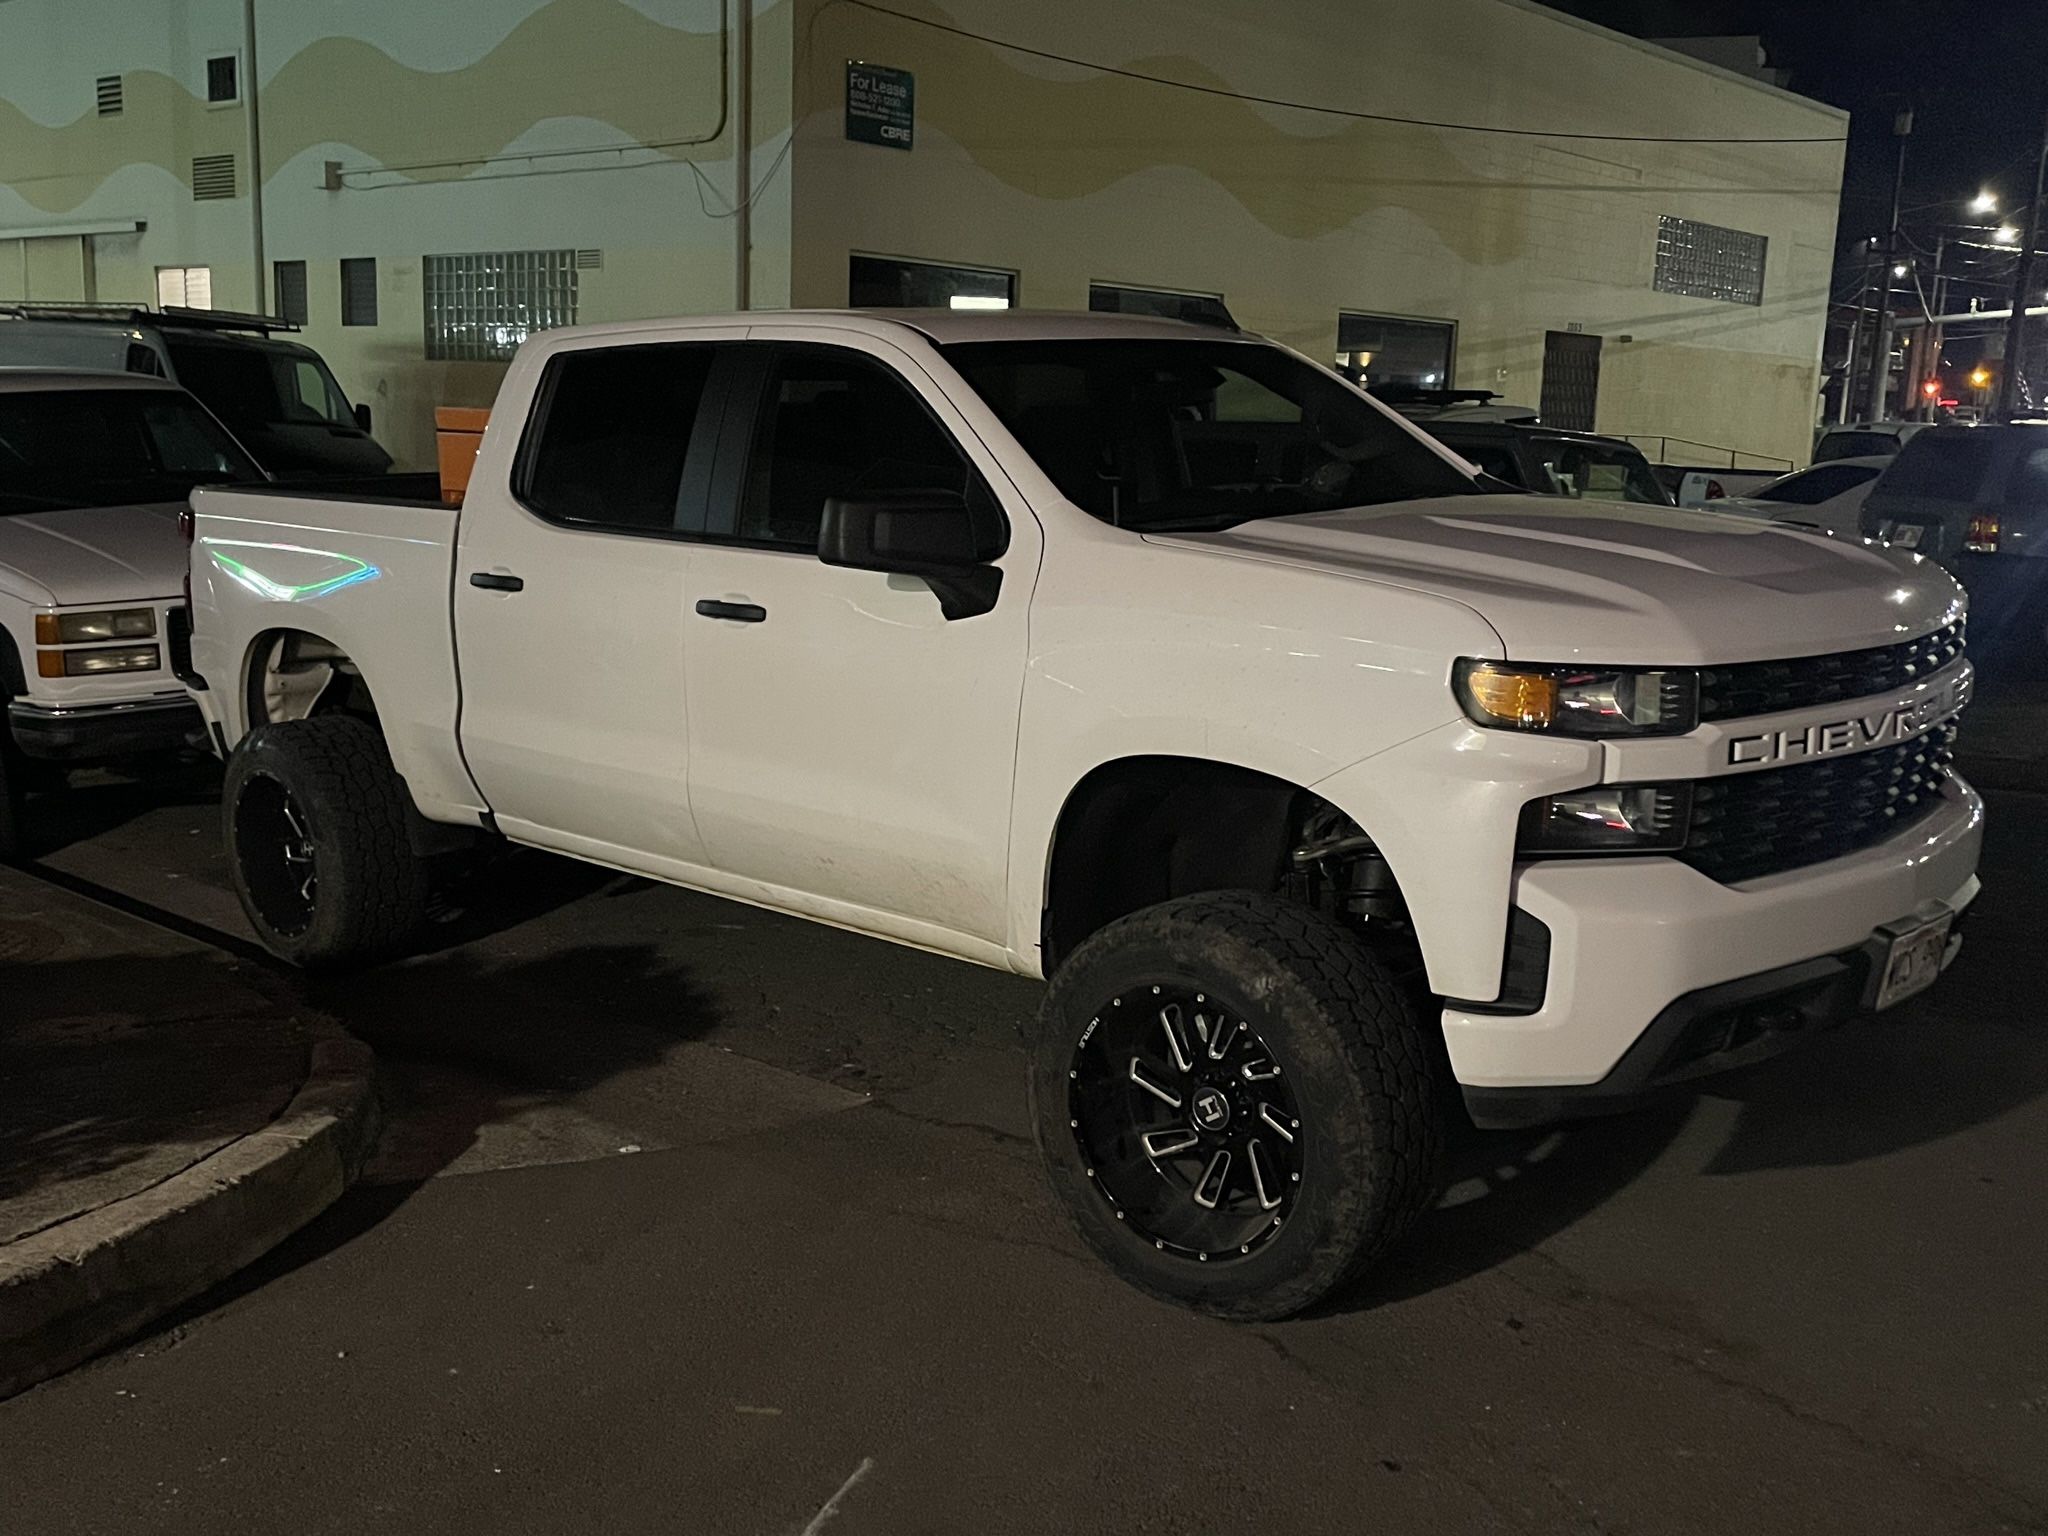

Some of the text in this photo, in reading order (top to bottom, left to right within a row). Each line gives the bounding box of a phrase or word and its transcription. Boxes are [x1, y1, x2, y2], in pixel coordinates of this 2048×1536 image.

[849, 72, 870, 90] For
[872, 76, 907, 97] Lease
[879, 125, 911, 141] CBRE
